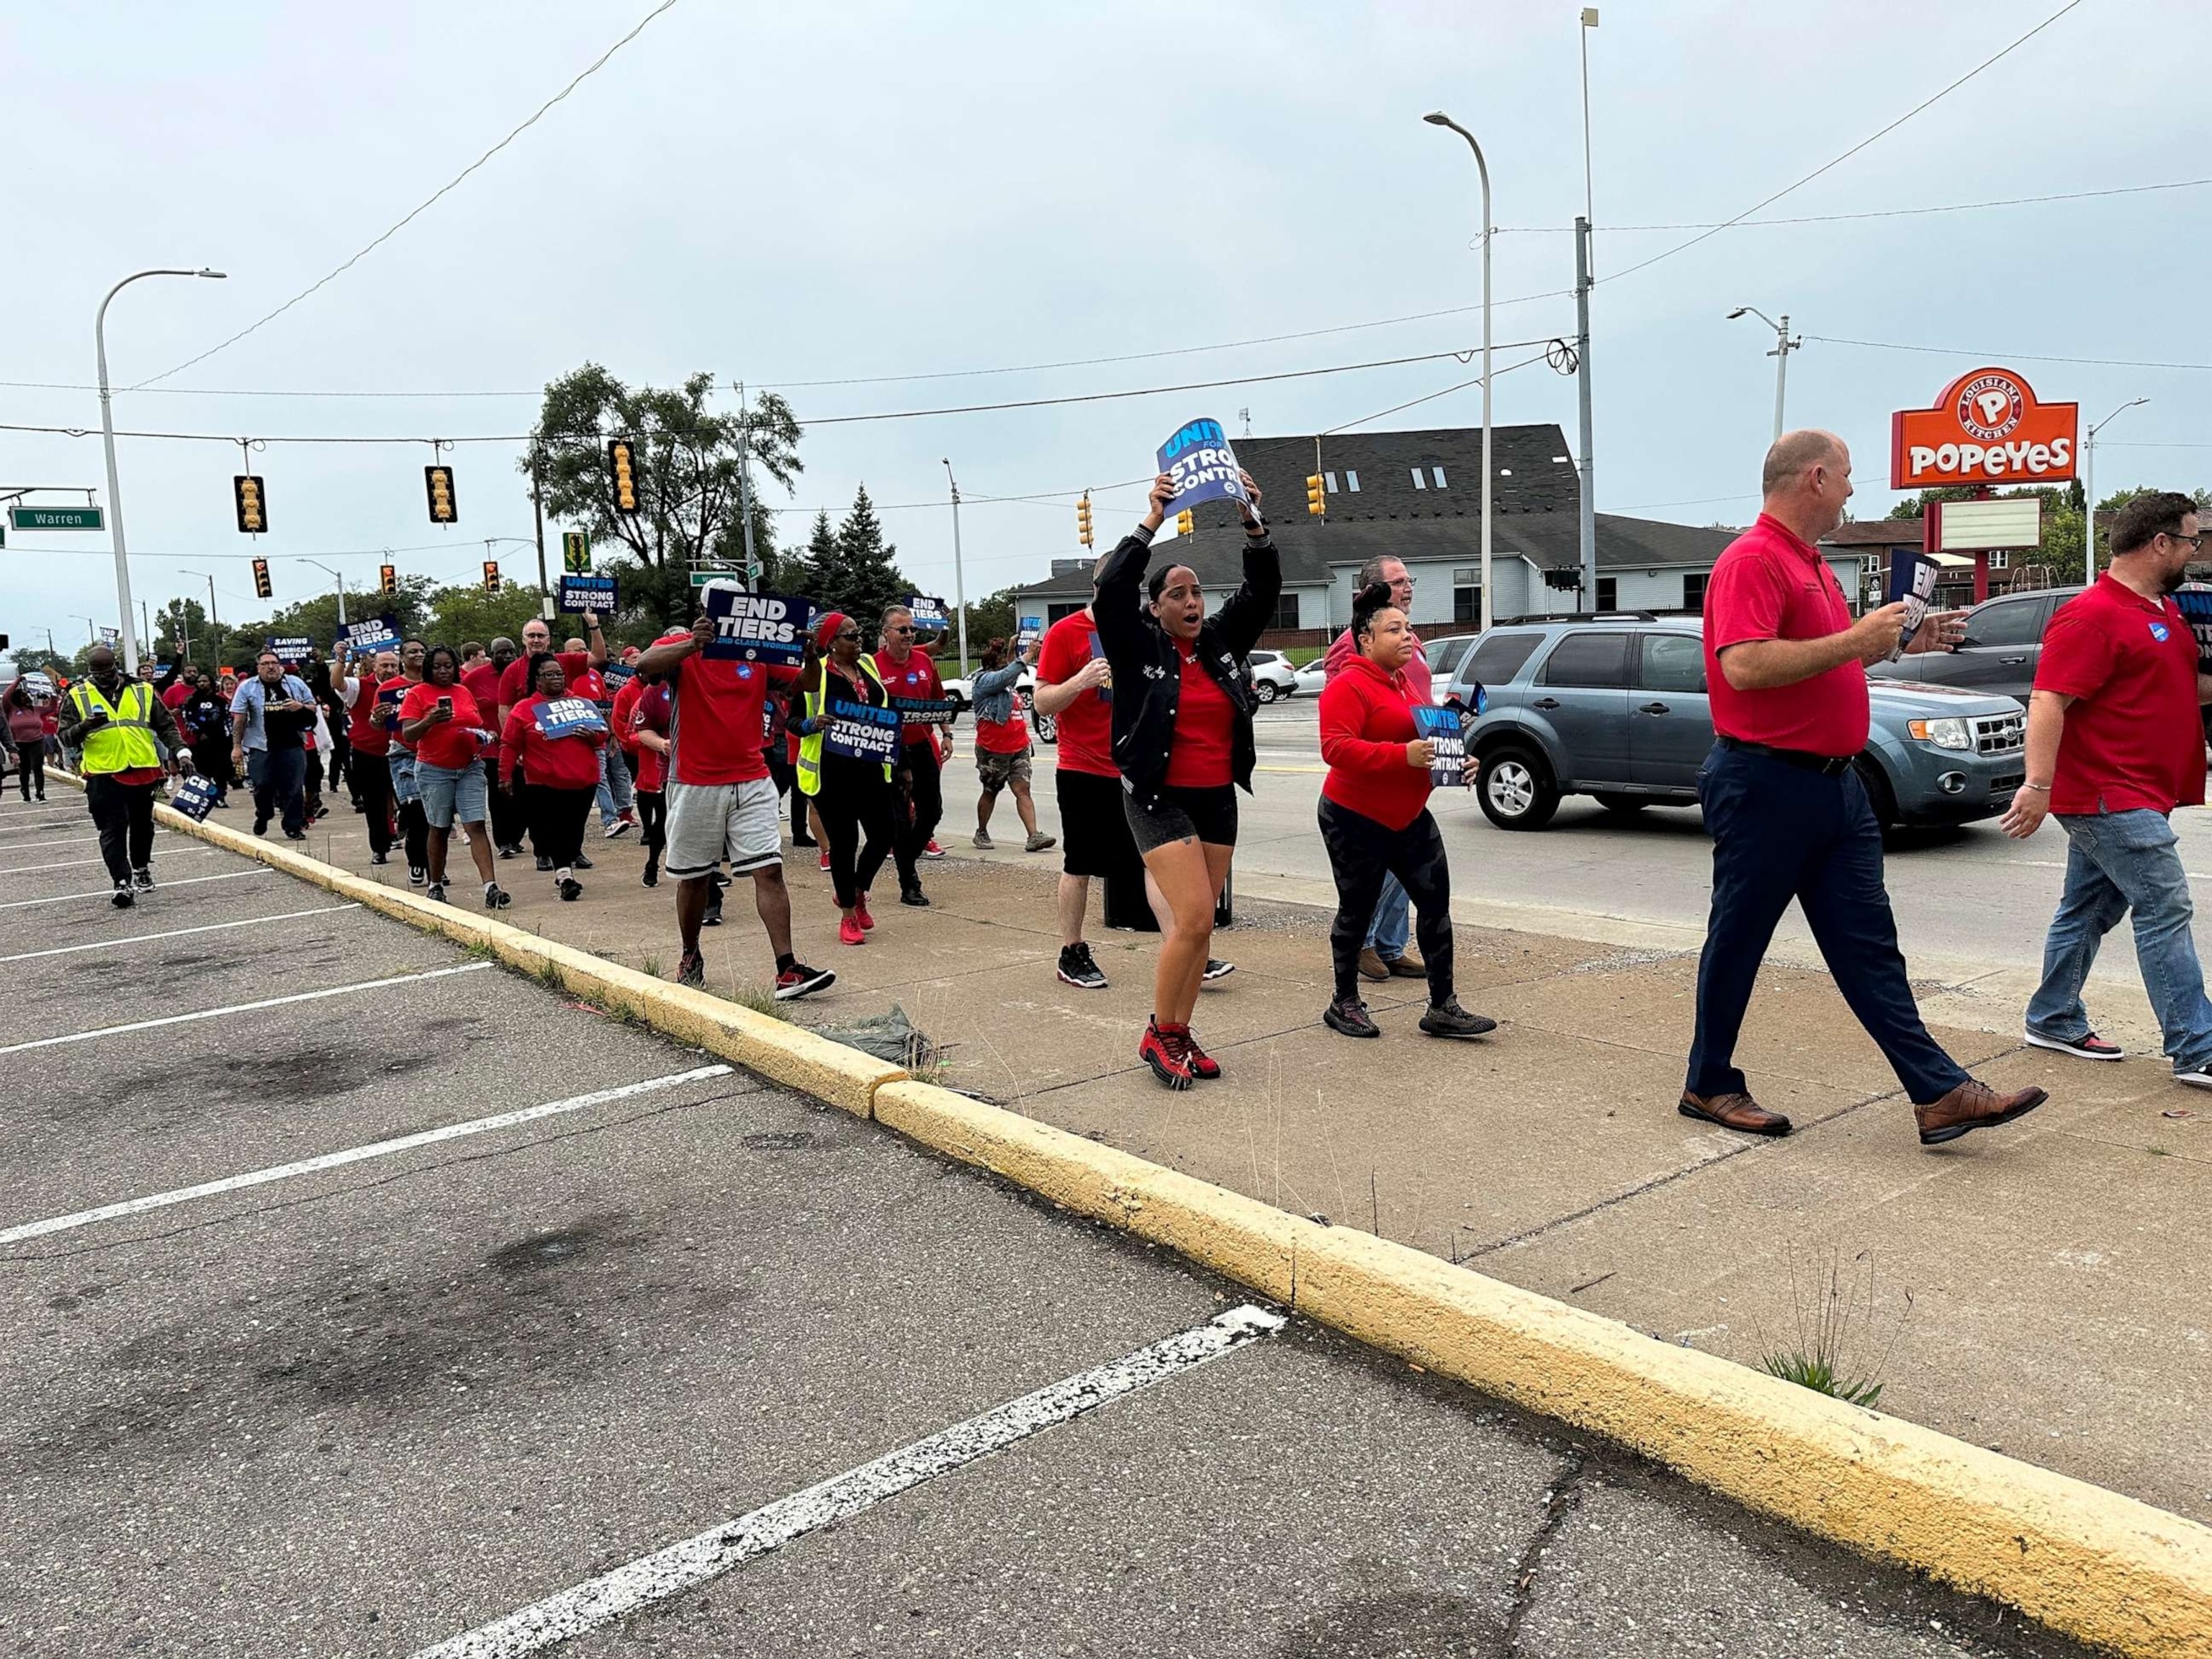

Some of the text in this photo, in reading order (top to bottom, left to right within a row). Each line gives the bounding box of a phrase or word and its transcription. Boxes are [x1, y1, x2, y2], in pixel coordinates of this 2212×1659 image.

[1961, 378, 2021, 406] LOUISIANA
[1977, 391, 2008, 424] P
[1963, 418, 2019, 439] KITCHEN
[1202, 440, 1223, 449] FOR
[35, 513, 82, 525] Warren
[566, 577, 614, 588] UNITED
[565, 590, 614, 601] STRONG
[564, 599, 616, 609] CONTRACT
[730, 595, 787, 621] END
[912, 597, 935, 610] END
[909, 607, 943, 620] TIERS
[347, 619, 383, 637] END
[717, 616, 795, 643] TIERS
[274, 637, 308, 646] SAVING
[343, 628, 394, 649] TIERS
[734, 638, 760, 647] CLASS
[762, 640, 803, 652] WORKERS
[271, 646, 313, 655] AMERICAN
[547, 698, 585, 713] END
[835, 699, 898, 724] UNITED
[894, 698, 956, 710] UNITED
[546, 709, 598, 726] TIERS
[1419, 709, 1460, 730] UNITED
[830, 732, 894, 754] CONTRACT
